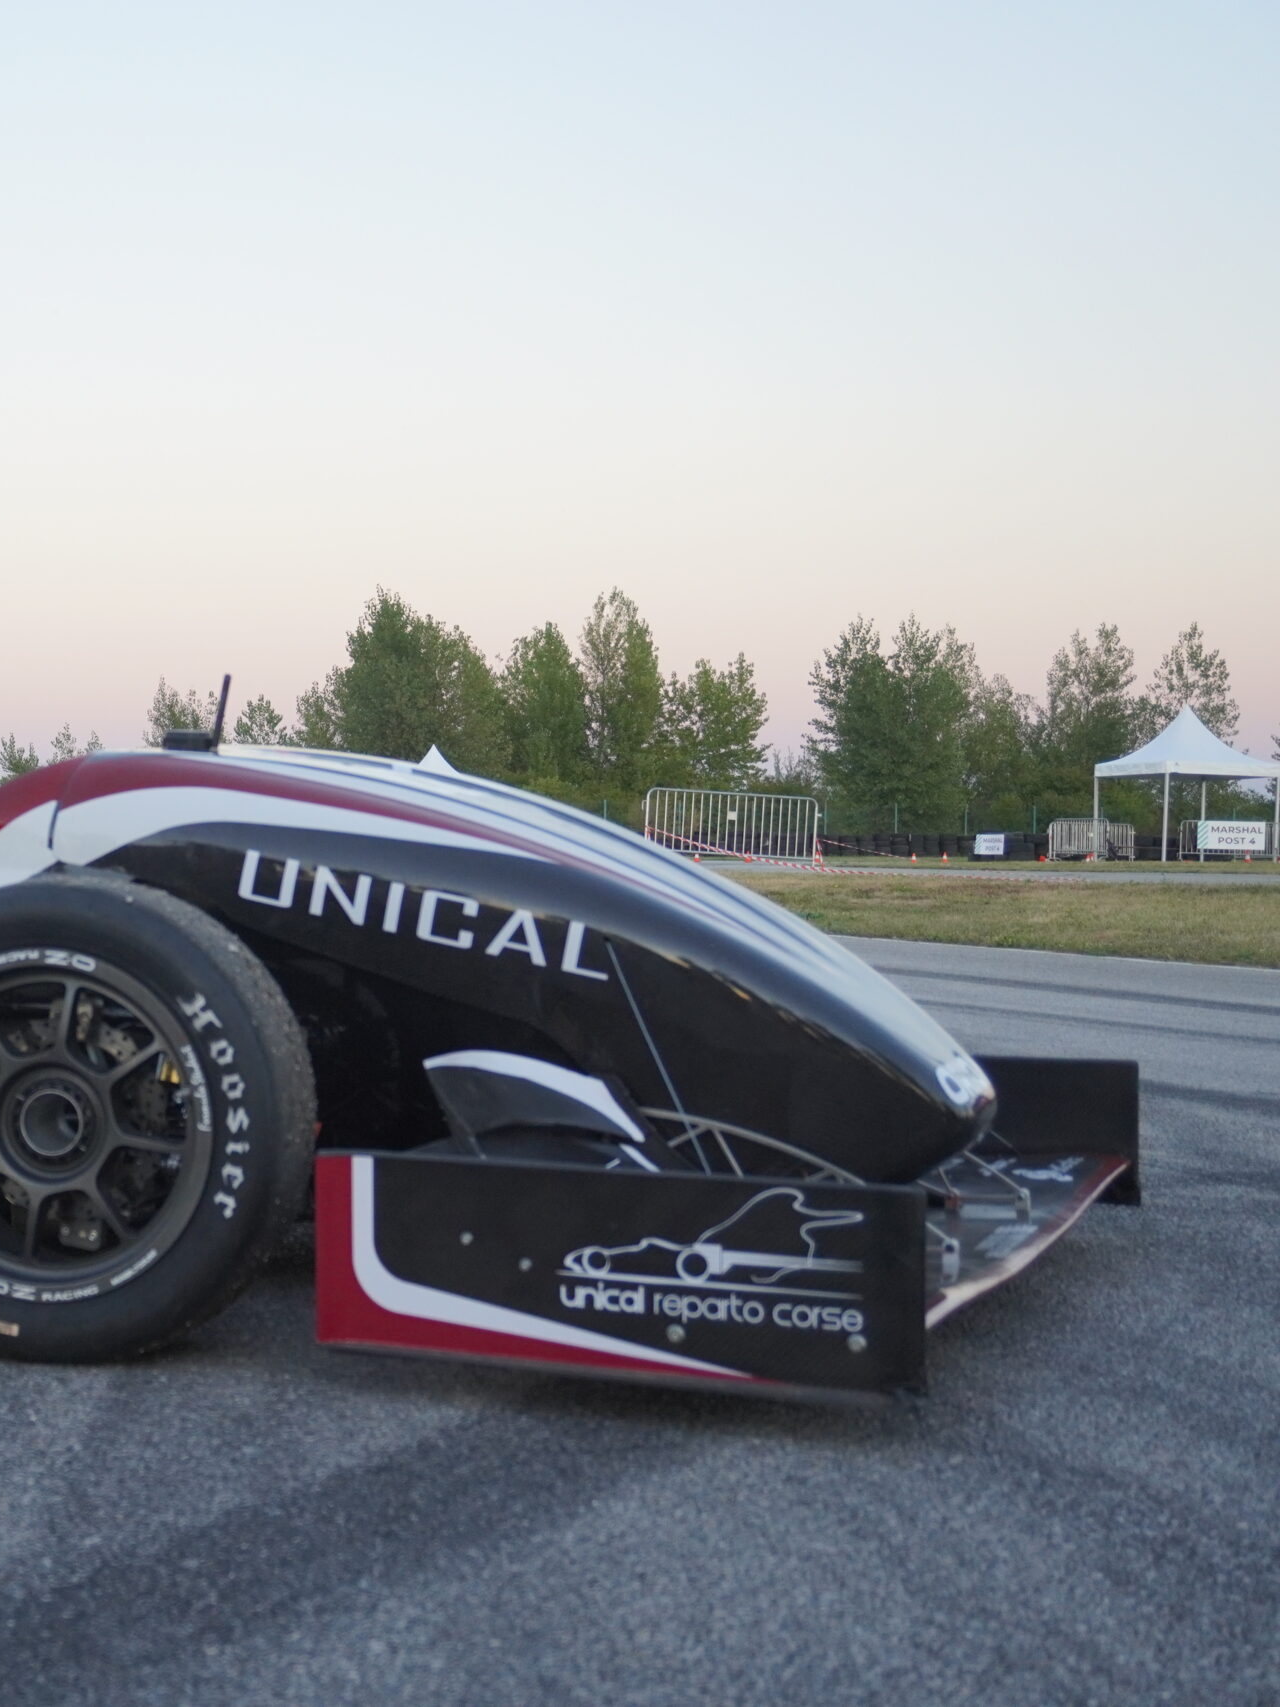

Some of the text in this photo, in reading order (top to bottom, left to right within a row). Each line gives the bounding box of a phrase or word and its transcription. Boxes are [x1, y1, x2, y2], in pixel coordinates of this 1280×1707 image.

[1211, 825, 1264, 835] MARSHAL
[1217, 836, 1256, 845] POST 4
[237, 849, 609, 982] UNICAL
[43, 949, 97, 973] OZ
[178, 992, 250, 1219] Hoosier
[41, 1283, 100, 1302] RACING
[559, 1280, 864, 1333] unical reparto corse
